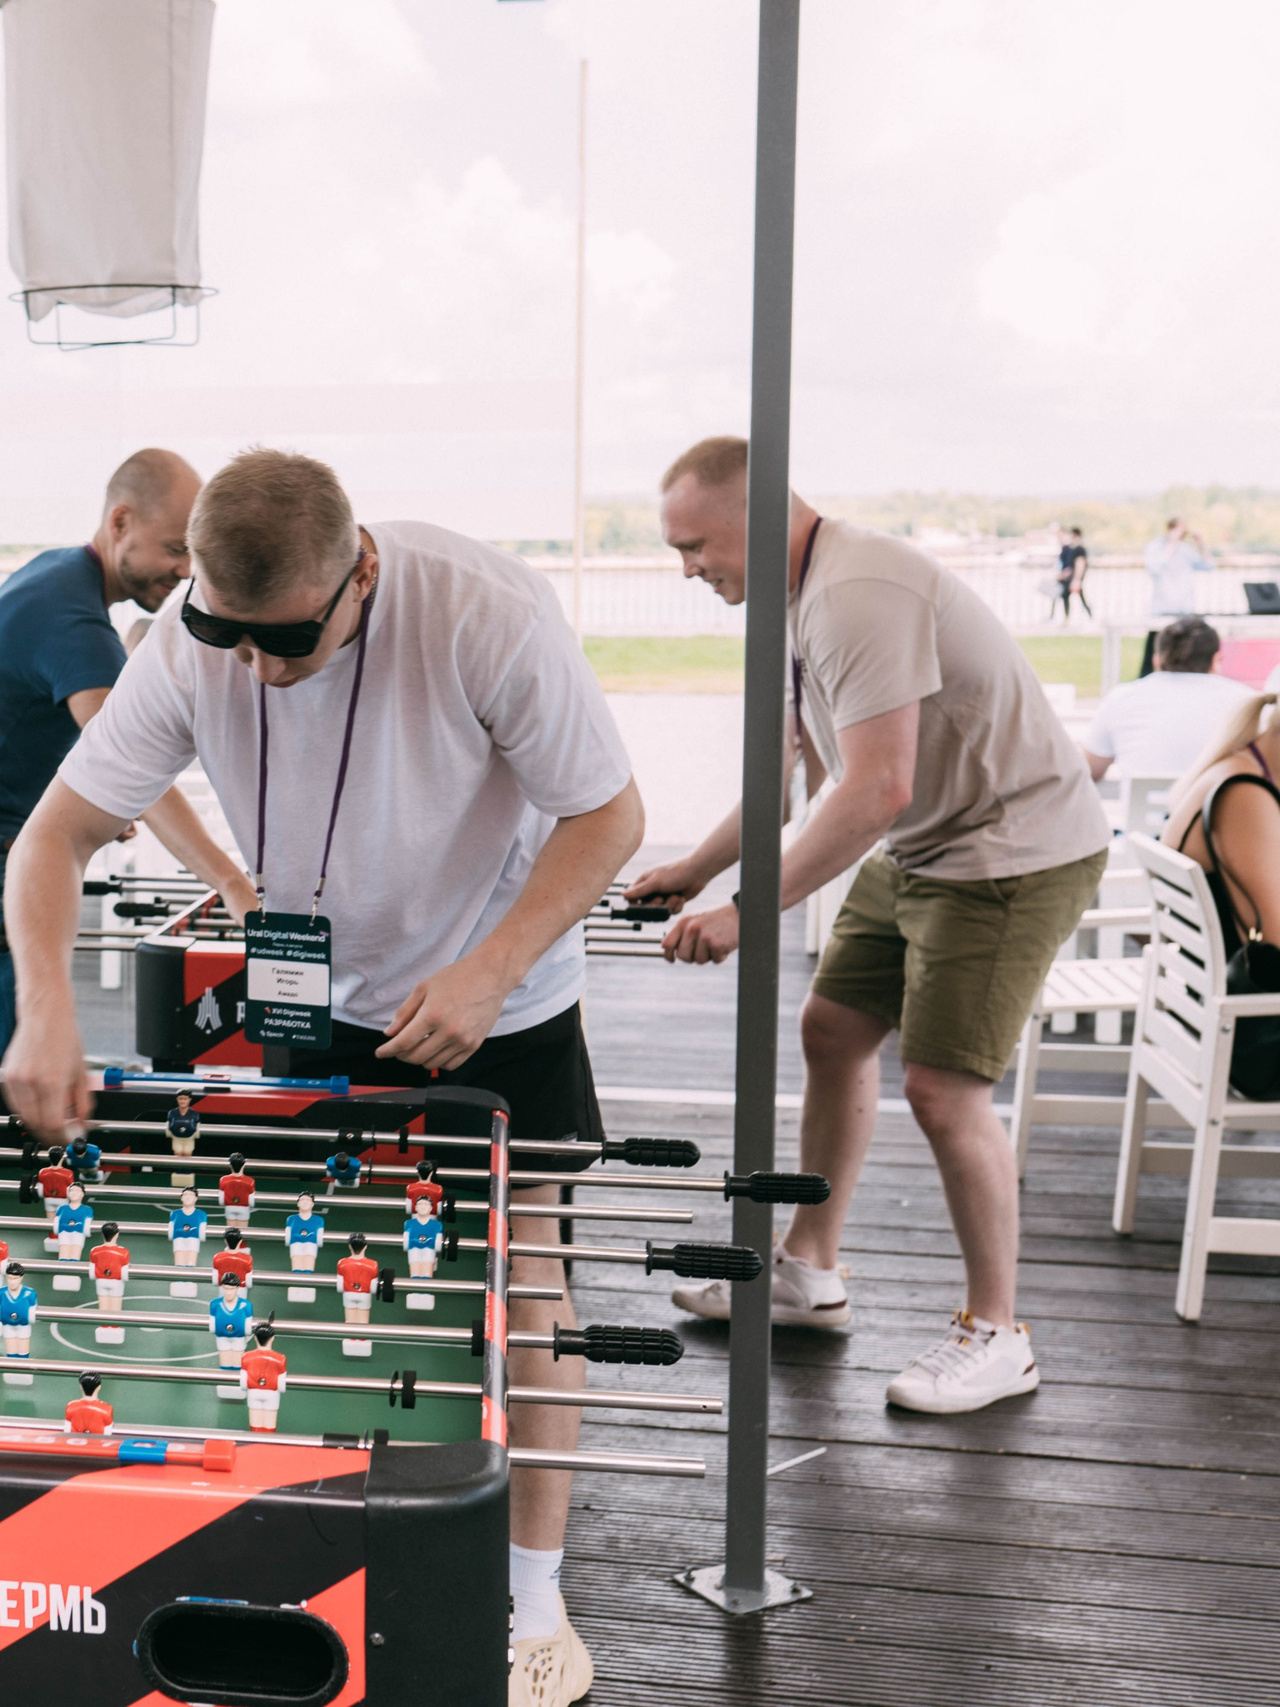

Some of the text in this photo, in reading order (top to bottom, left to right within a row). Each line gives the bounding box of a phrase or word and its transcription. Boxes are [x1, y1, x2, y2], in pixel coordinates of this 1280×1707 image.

[247, 928, 263, 938] Ural
[263, 929, 289, 940] Digital
[289, 931, 326, 943] Weekend
[250, 947, 326, 960] #udweek #digiweek
[276, 977, 299, 986] Игорь
[264, 1017, 312, 1029] РАЗРАБОТКА
